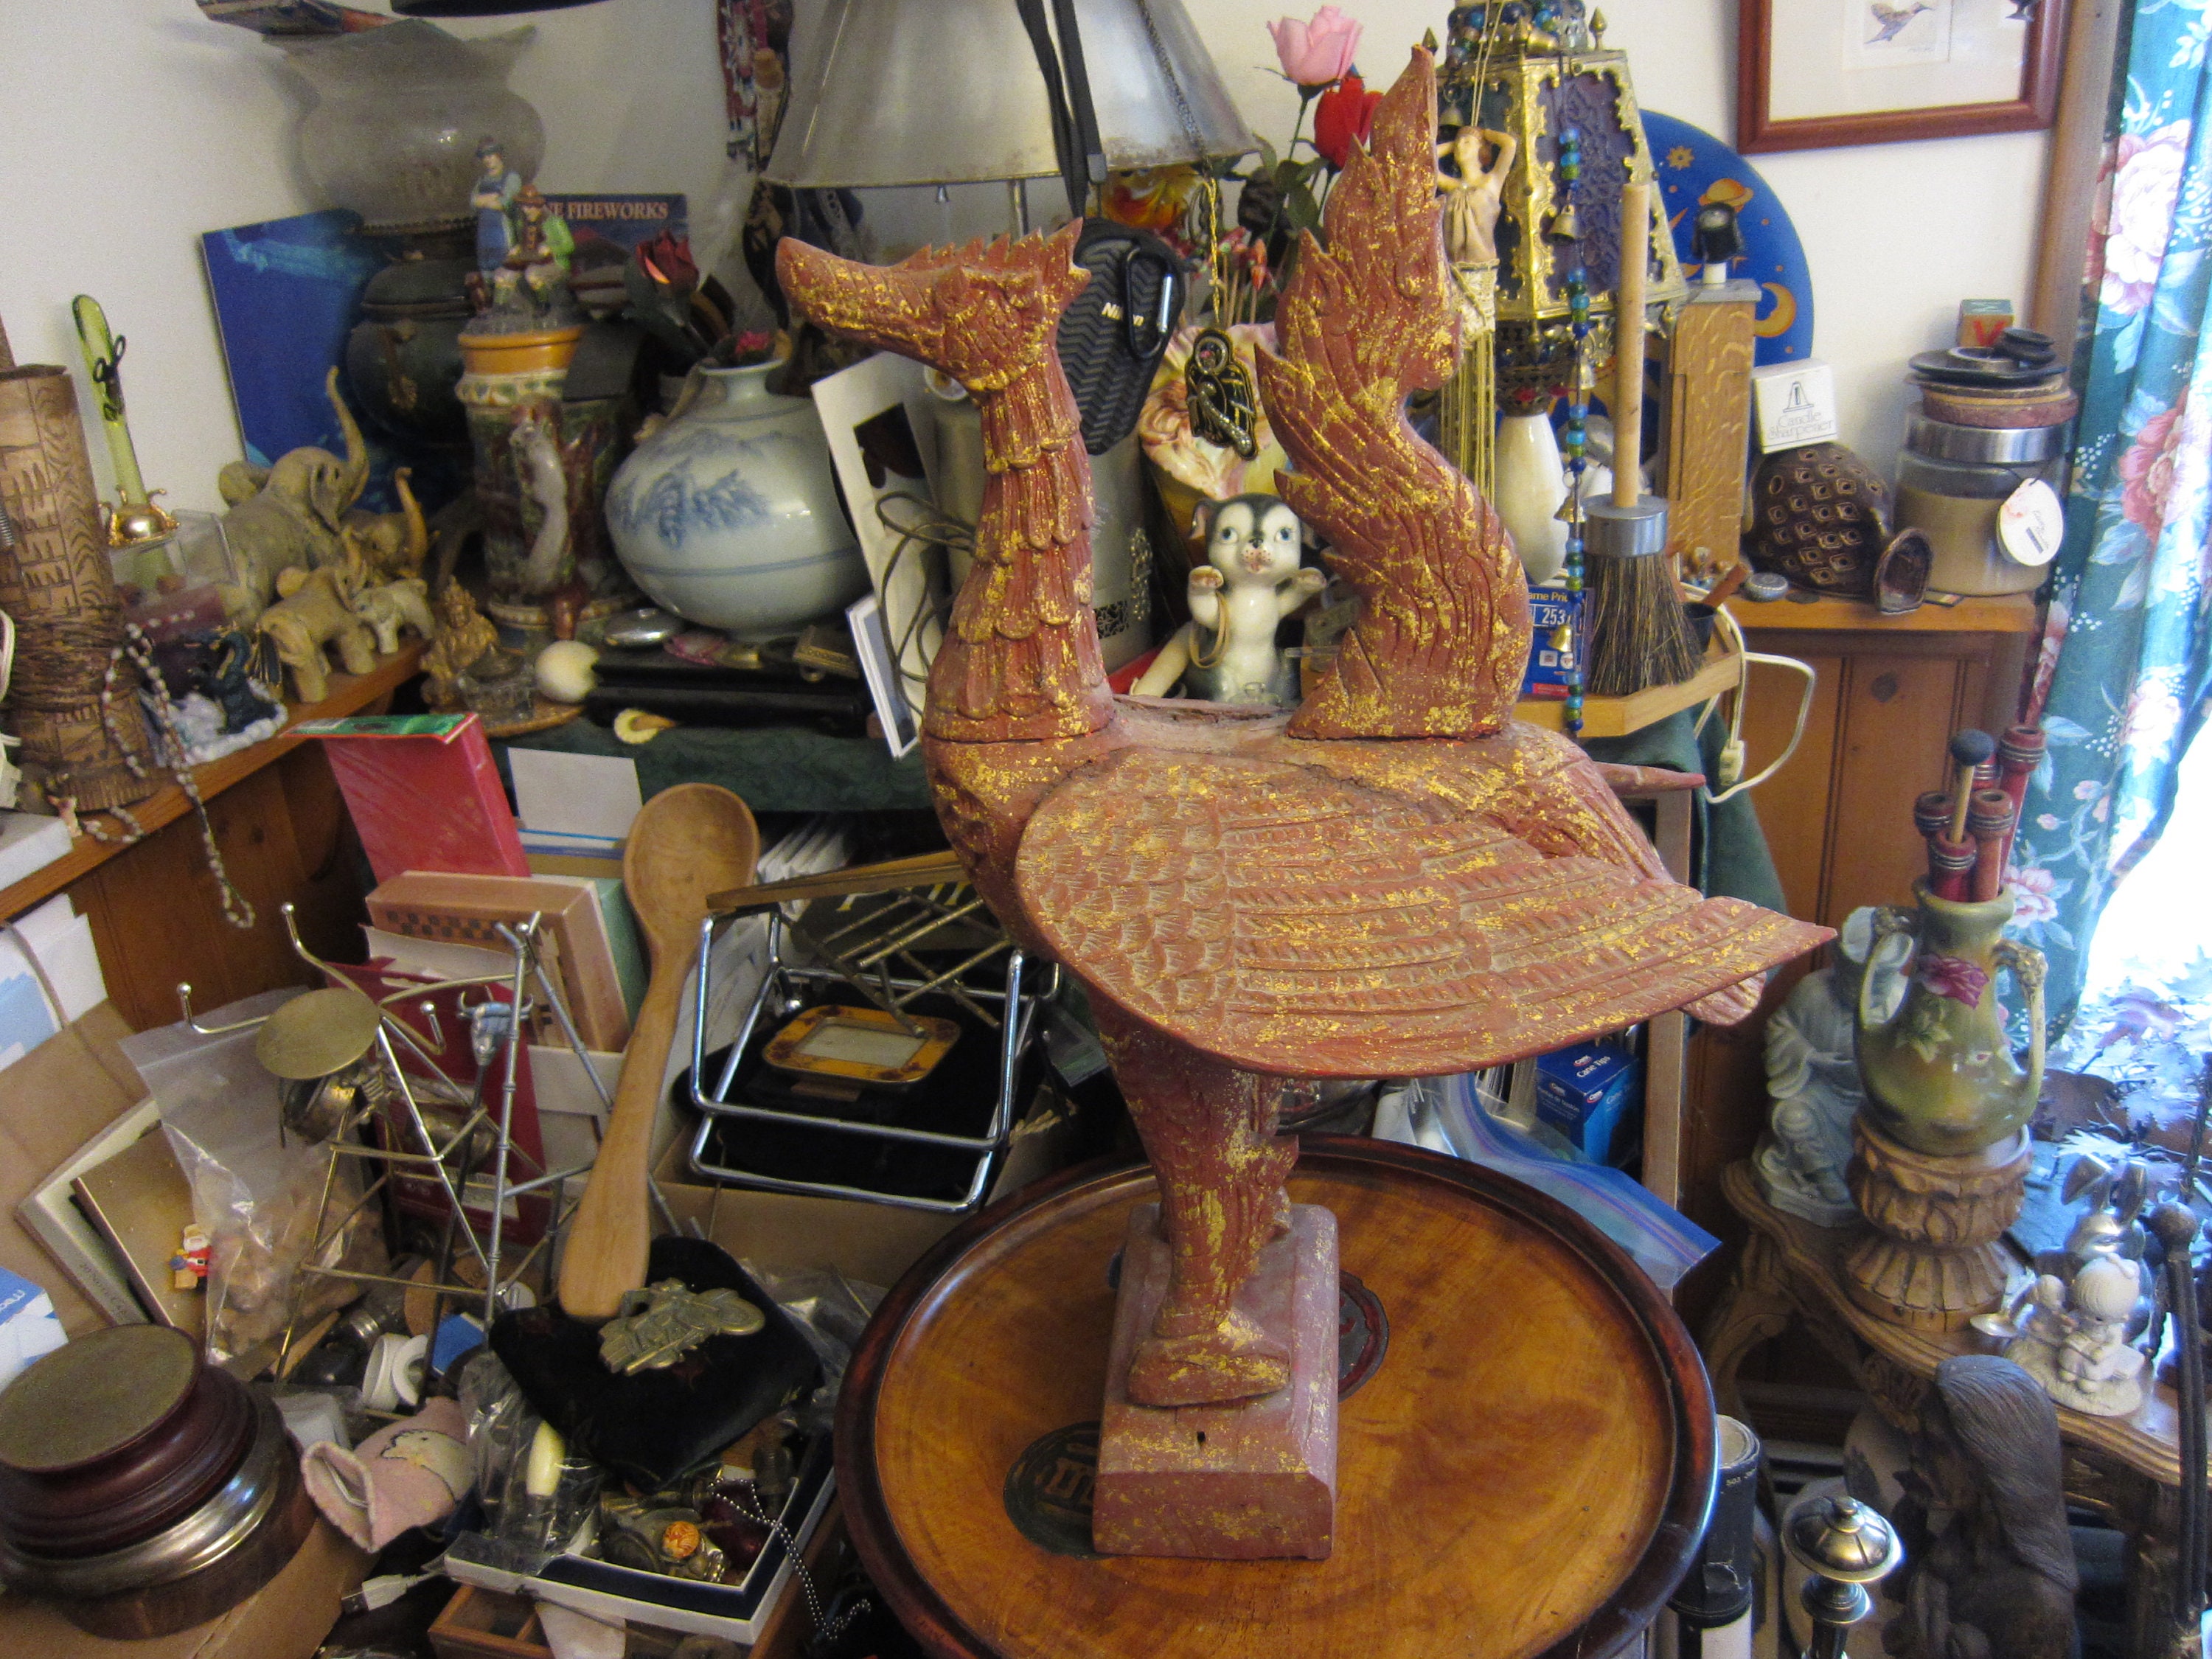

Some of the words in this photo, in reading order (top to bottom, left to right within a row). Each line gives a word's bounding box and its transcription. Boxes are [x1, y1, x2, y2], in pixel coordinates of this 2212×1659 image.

[567, 201, 669, 220] FIREWORKS
[1778, 408, 1822, 428] Candle
[1769, 420, 1834, 440] Sharpener
[1542, 607, 1566, 625] 253
